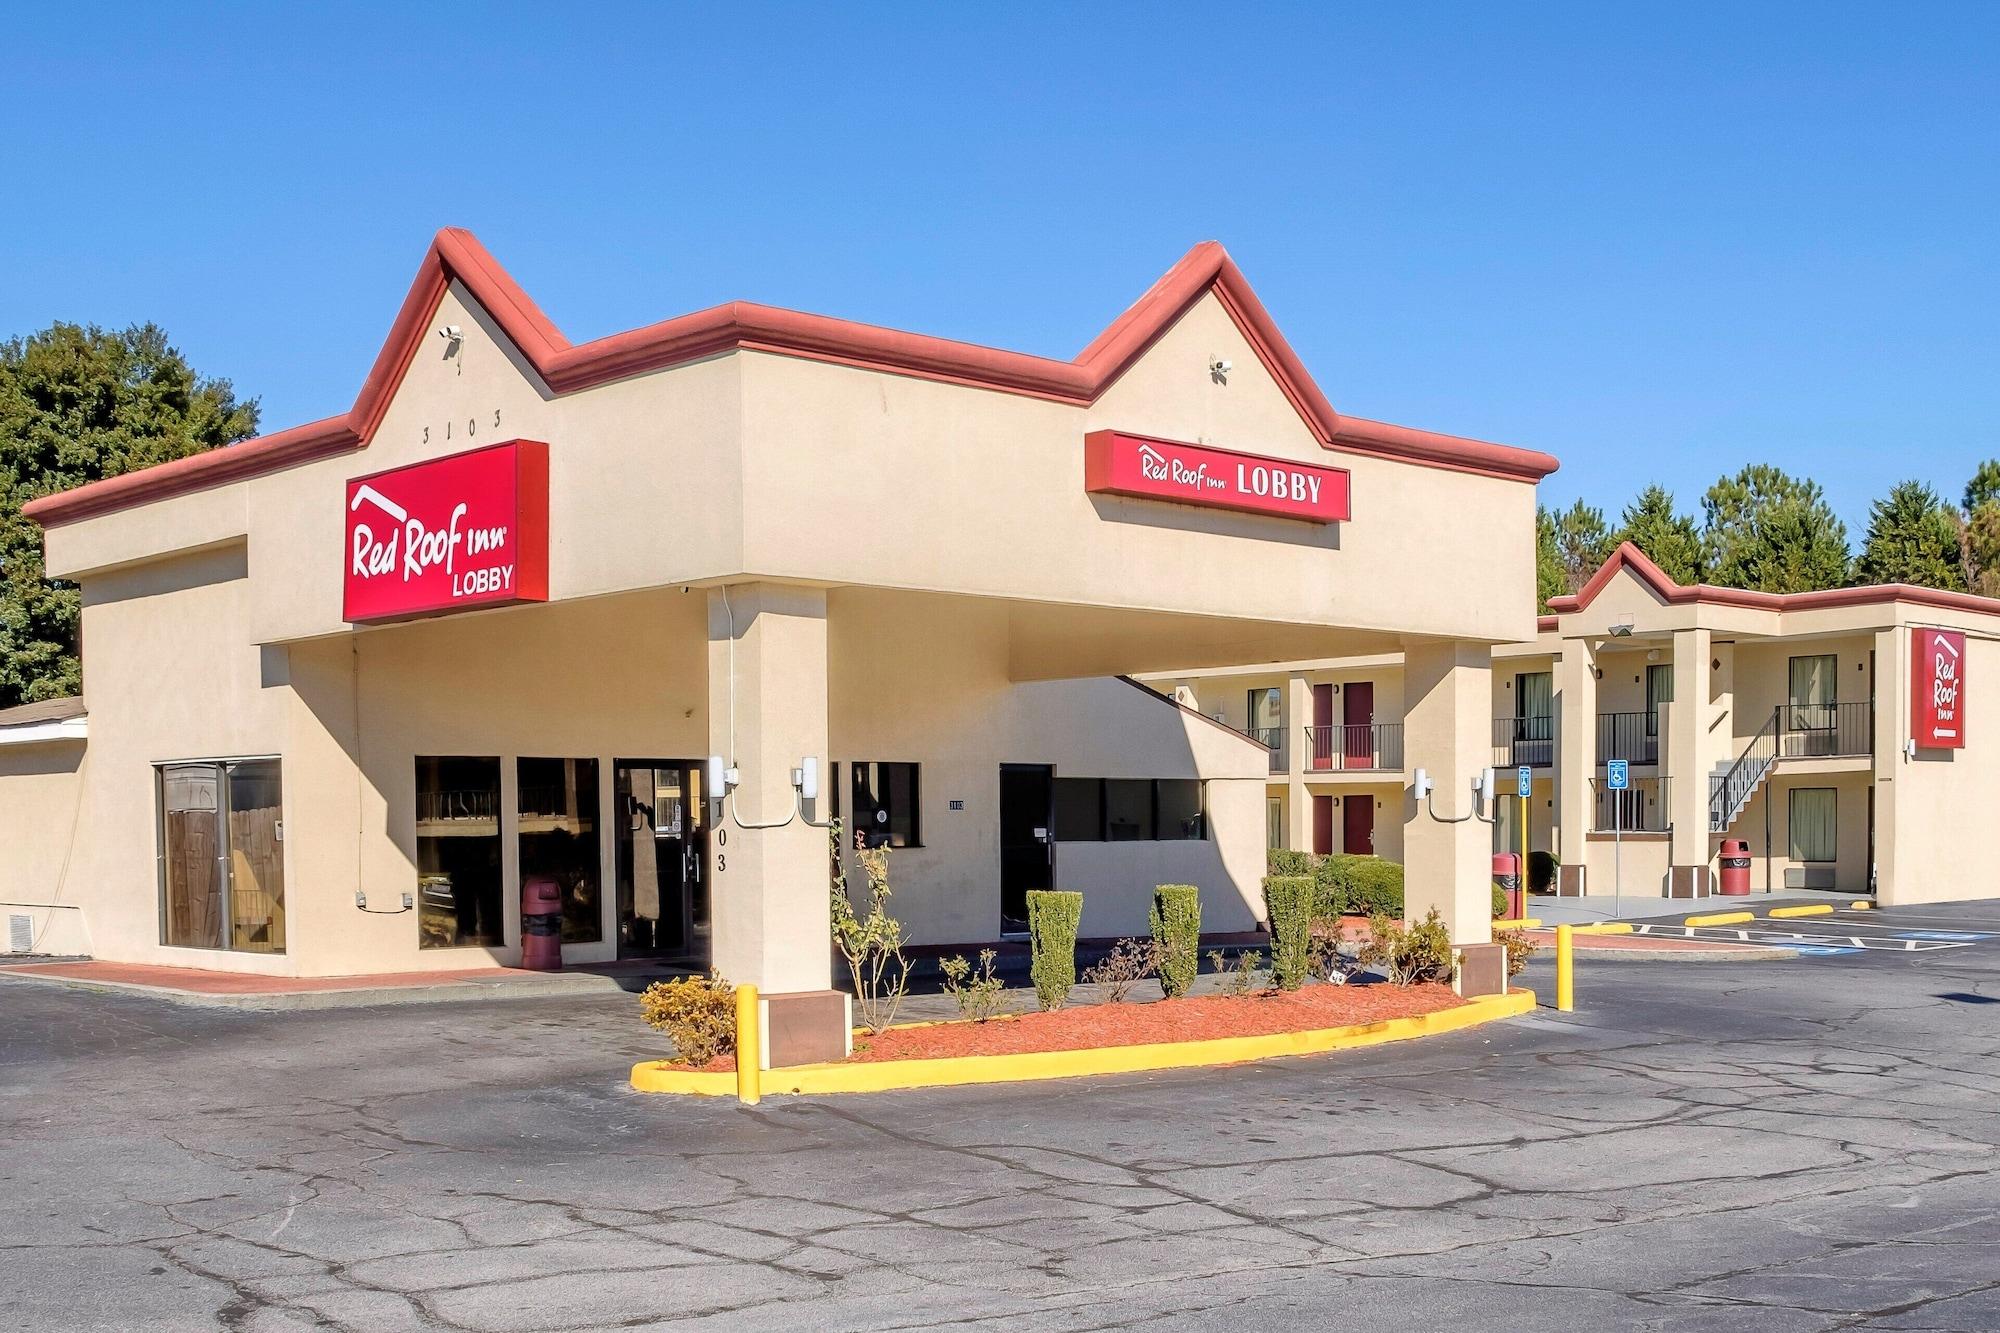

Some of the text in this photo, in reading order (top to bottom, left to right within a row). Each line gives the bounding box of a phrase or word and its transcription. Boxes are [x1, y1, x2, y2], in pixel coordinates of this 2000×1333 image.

[1142, 453, 1168, 480] Red
[1172, 458, 1206, 491] Roof
[1237, 463, 1322, 504] LOBBY
[353, 524, 398, 578] Red
[403, 502, 467, 582] Roof
[452, 564, 513, 597] LOBBY
[1936, 653, 1955, 680] Red
[1934, 679, 1959, 709] Roof
